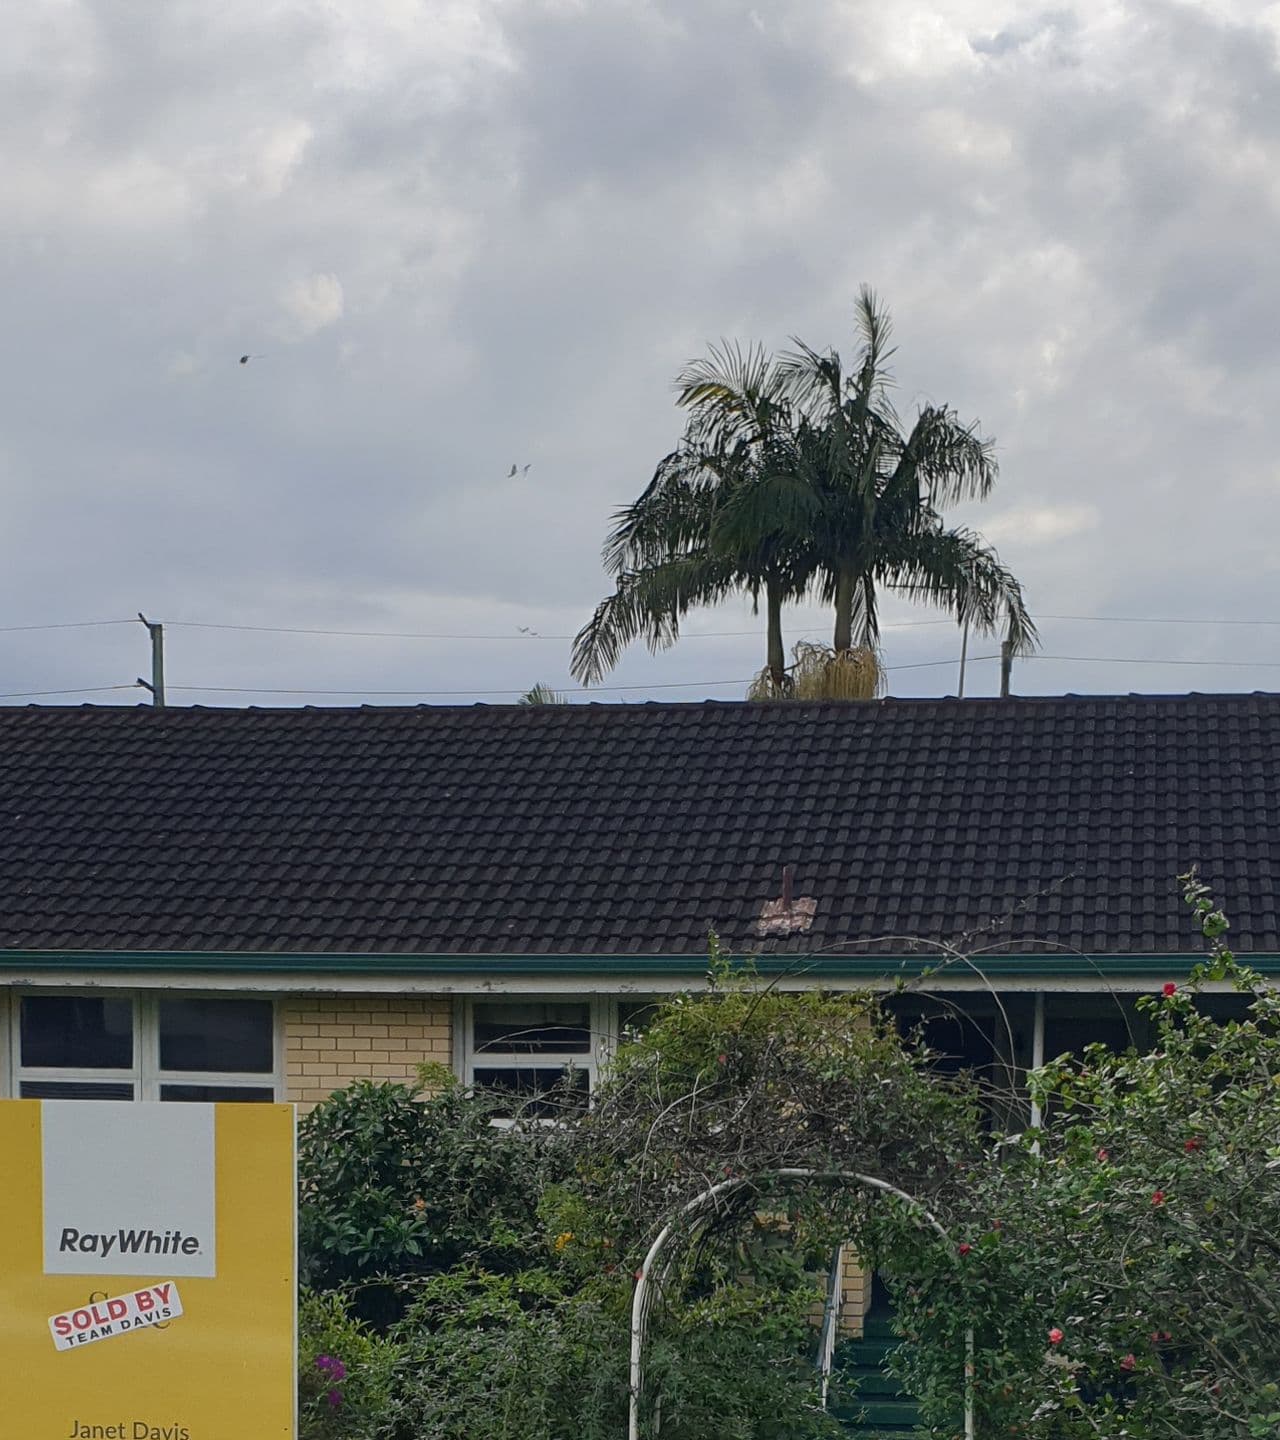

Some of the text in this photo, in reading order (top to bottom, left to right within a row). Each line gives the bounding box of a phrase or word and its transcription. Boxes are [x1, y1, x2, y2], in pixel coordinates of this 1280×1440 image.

[54, 1283, 171, 1336] SOLD BY
[65, 1307, 171, 1346] TEAM DAVIS
[69, 1420, 190, 1440] Janet Davis
